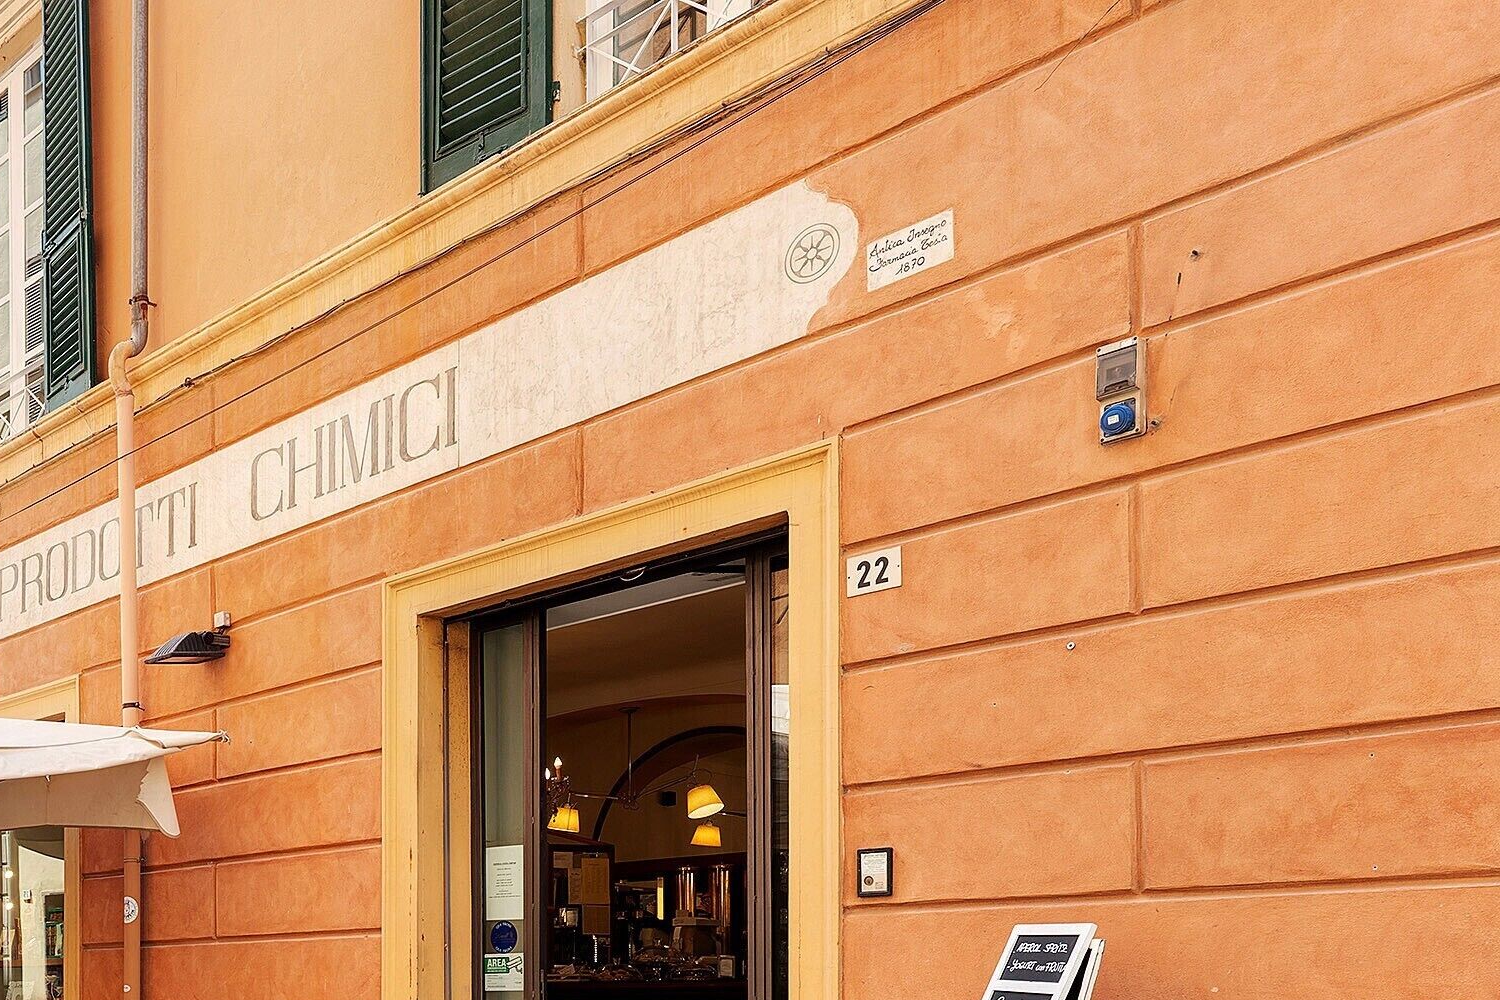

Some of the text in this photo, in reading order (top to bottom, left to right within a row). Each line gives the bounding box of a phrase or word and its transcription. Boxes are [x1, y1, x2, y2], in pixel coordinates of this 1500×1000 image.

[869, 240, 905, 259] Antica
[894, 256, 926, 276] 1870
[249, 366, 459, 523] CHIMICI
[856, 555, 890, 589] 22
[487, 958, 507, 968] AREA
